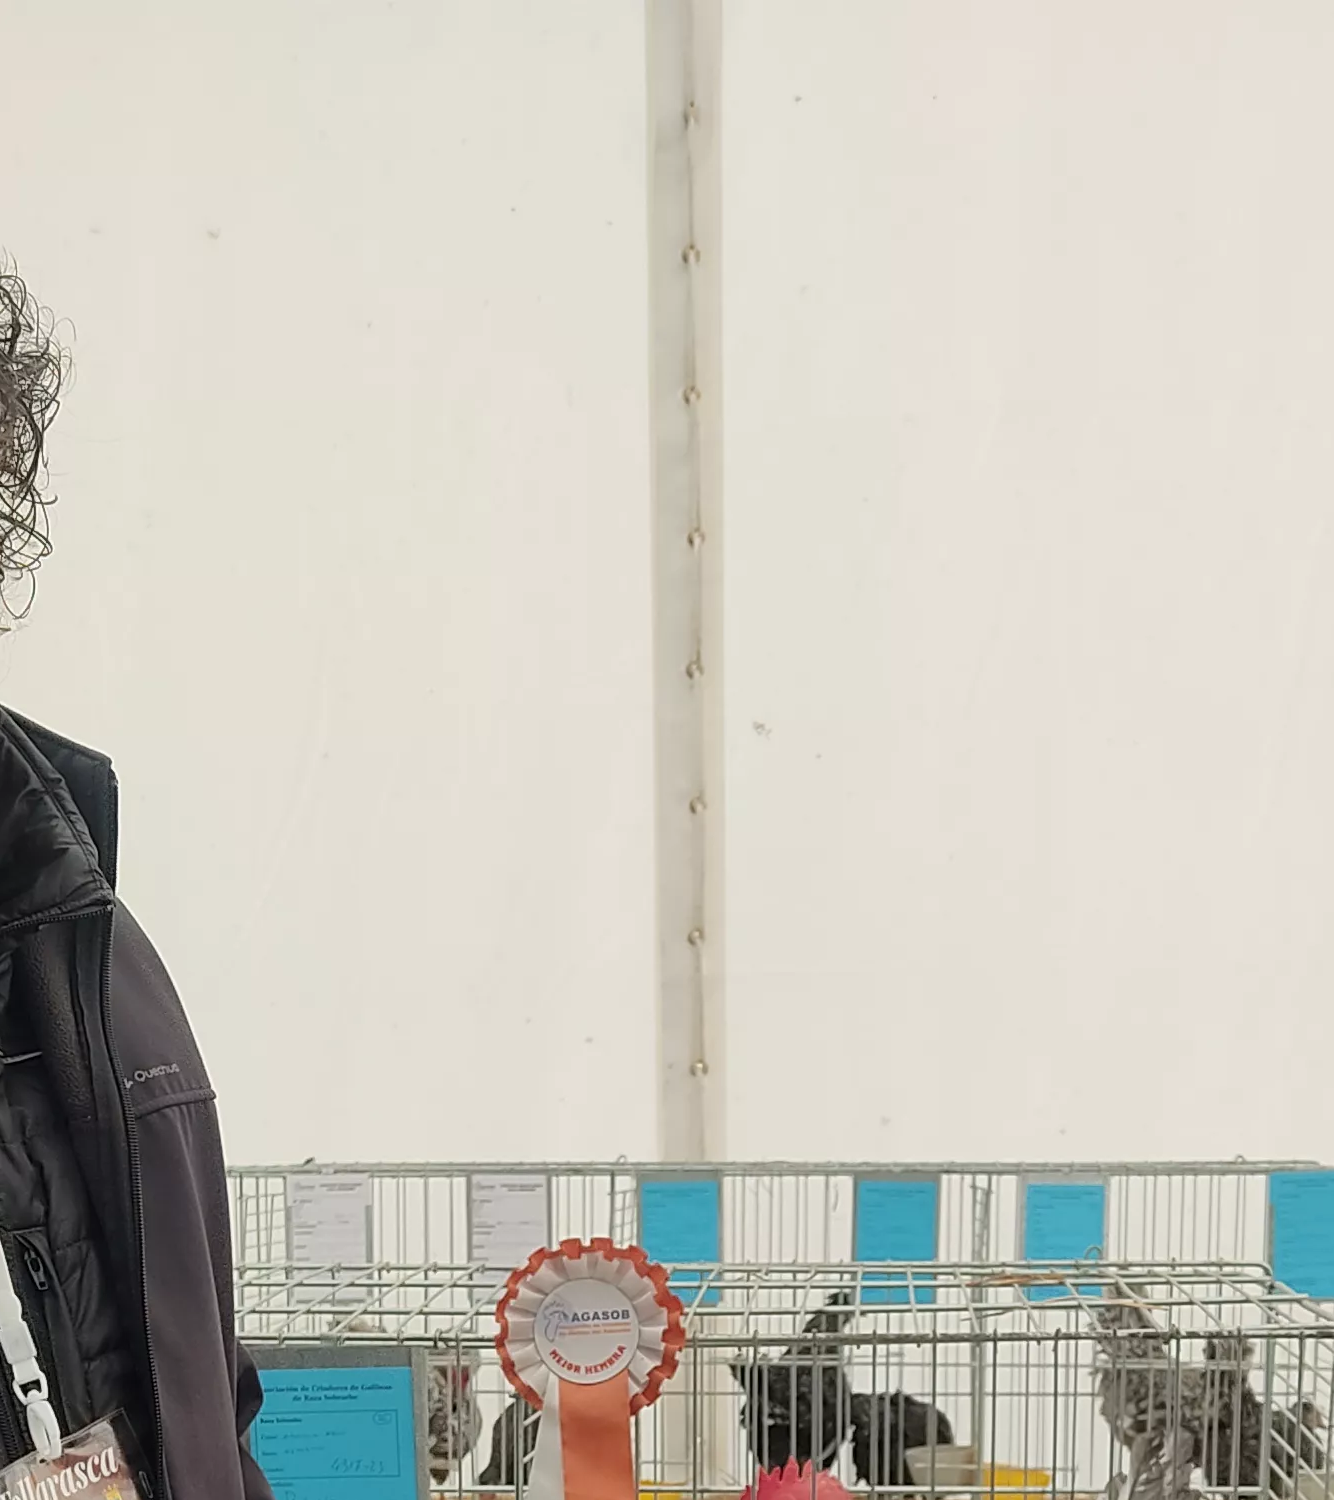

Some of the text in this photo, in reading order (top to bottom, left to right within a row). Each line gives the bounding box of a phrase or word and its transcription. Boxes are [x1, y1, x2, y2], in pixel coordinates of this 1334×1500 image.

[571, 1308, 631, 1323] AGASOB
[549, 1344, 627, 1375] MEJOR HEMBRA
